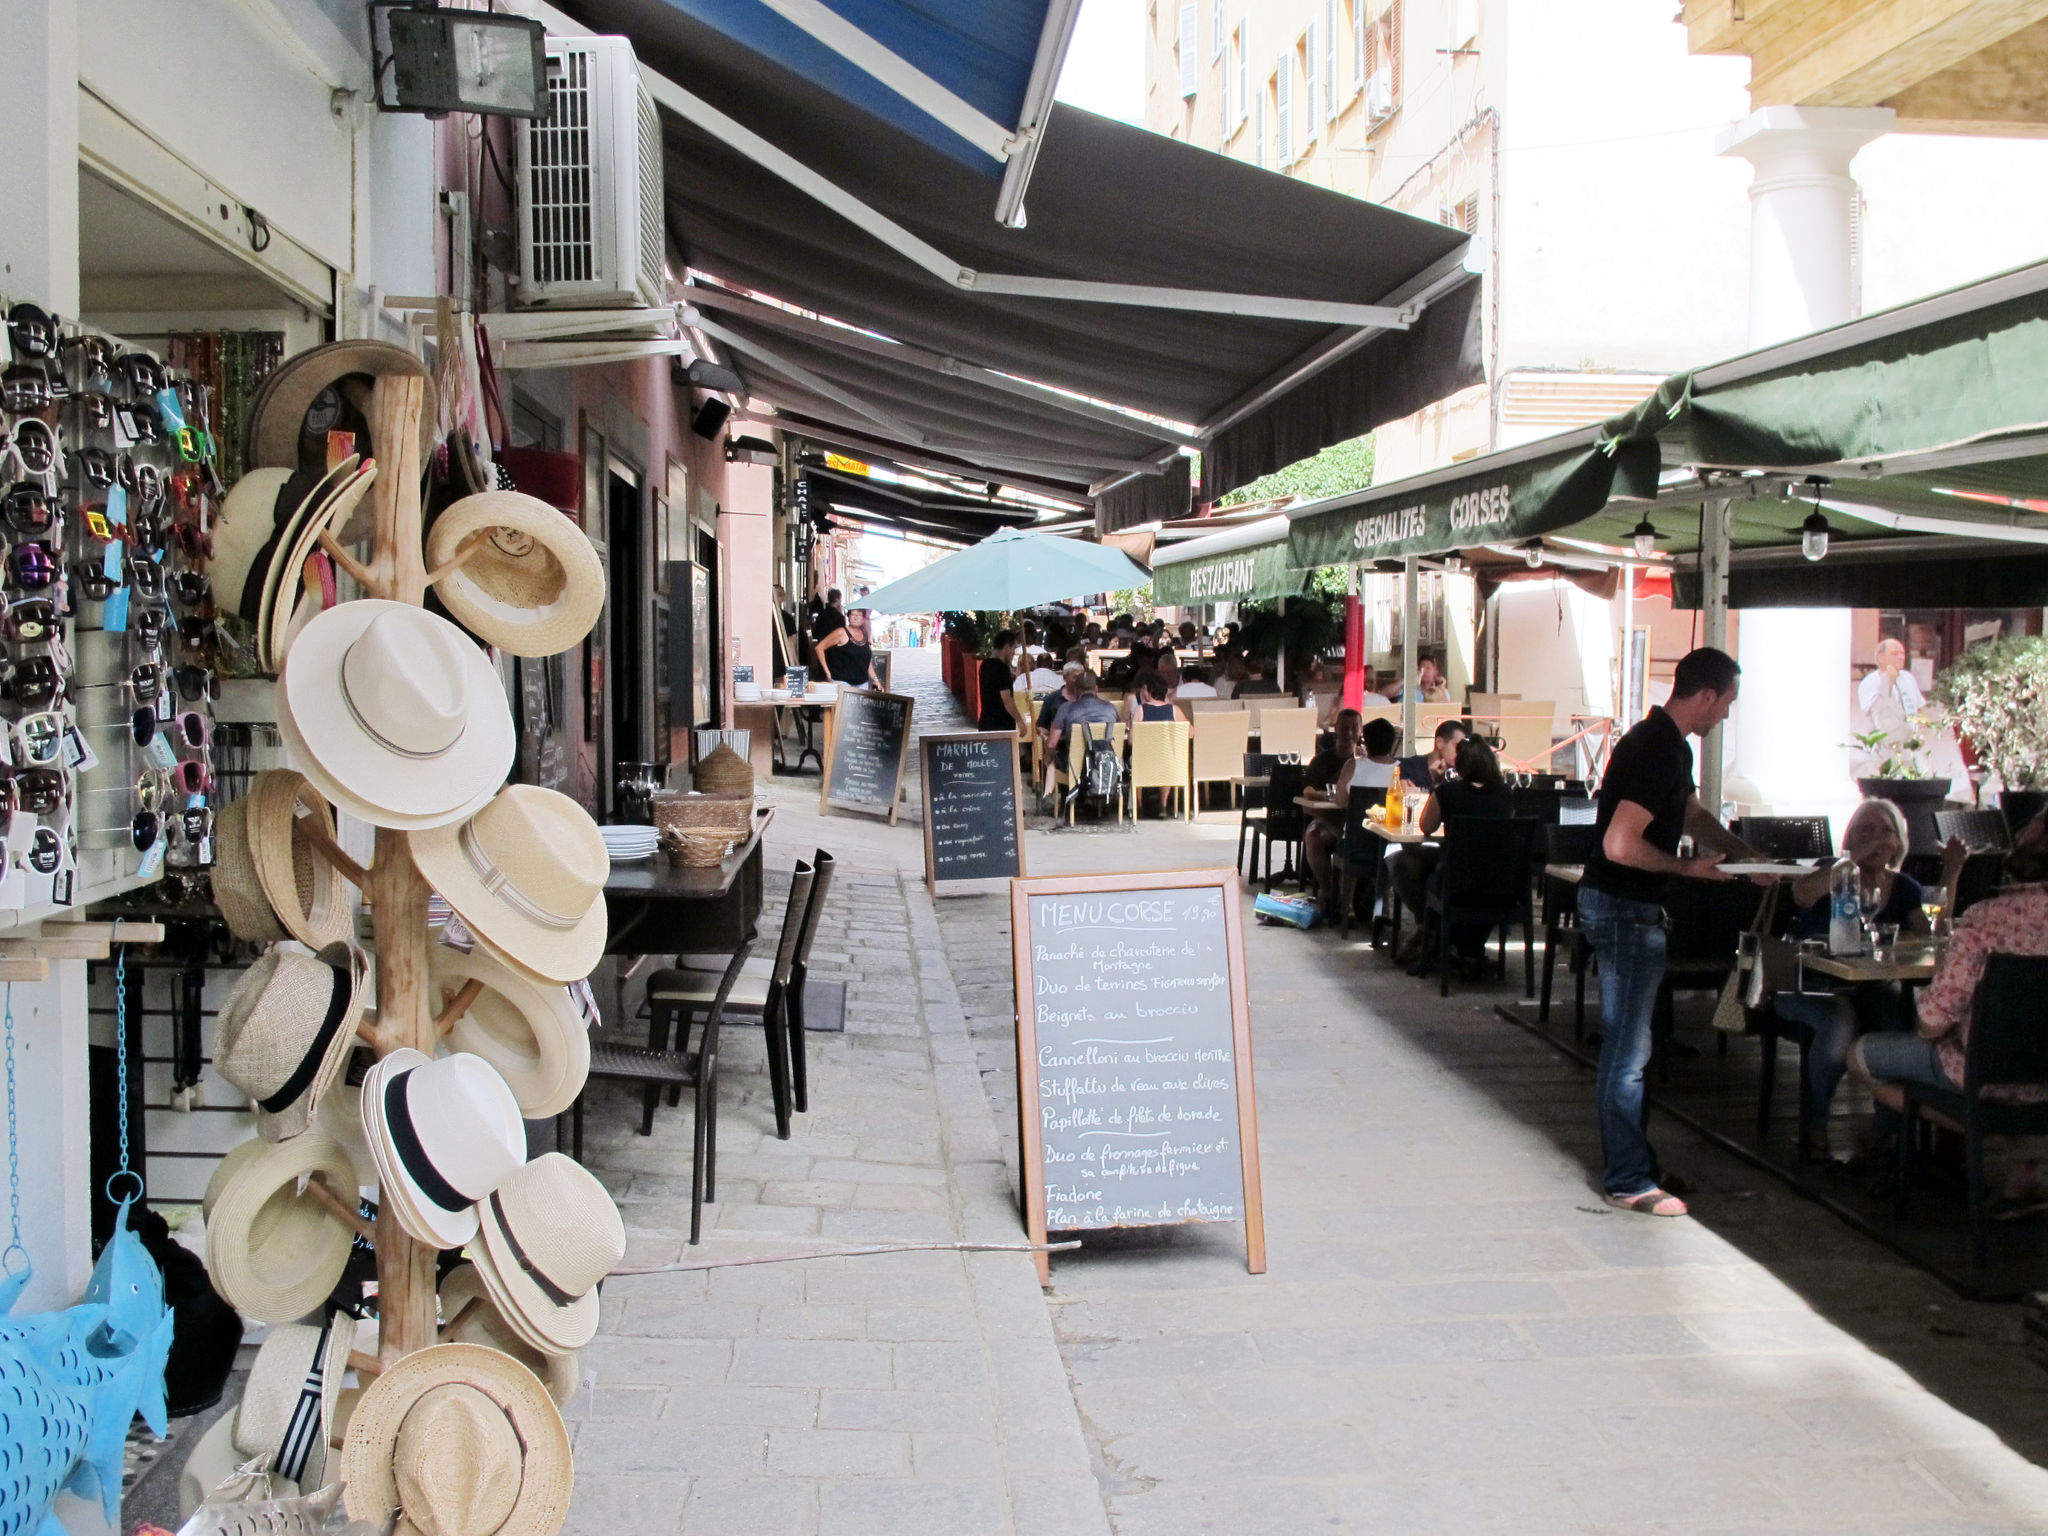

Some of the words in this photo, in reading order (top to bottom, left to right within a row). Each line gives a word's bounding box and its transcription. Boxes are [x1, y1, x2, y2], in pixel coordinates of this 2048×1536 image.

[1354, 503, 1426, 549] SPECIALITES
[1449, 483, 1511, 531] CORSES
[1189, 557, 1256, 598] RESTAURANT
[936, 742, 989, 757] MARMITE
[940, 762, 954, 771] DE
[1041, 901, 1102, 927] MENU
[1107, 900, 1176, 924] CORSE
[1091, 945, 1107, 959] de
[1109, 941, 1176, 958] charcuterie
[1036, 975, 1068, 995] Duo
[1075, 976, 1091, 991] de
[1104, 1010, 1127, 1019] au
[1039, 1045, 1118, 1067] Cannelloni
[1123, 1054, 1140, 1063] au
[1145, 1048, 1189, 1063] brocciu
[1111, 1076, 1126, 1091] de
[1130, 1077, 1159, 1091] veau
[1192, 1071, 1229, 1091] olives
[1108, 1108, 1123, 1124] de
[1157, 1104, 1172, 1122] de
[1177, 1105, 1223, 1122] dorade
[1044, 1143, 1075, 1164] Duo
[1080, 1146, 1095, 1161] de
[1100, 1143, 1159, 1169] fromages
[1081, 1168, 1096, 1178] sa
[1168, 1158, 1200, 1177] figue
[1045, 1183, 1103, 1203] Fiadone
[1046, 1207, 1077, 1225] Flan
[1083, 1210, 1093, 1224] à
[1095, 1205, 1109, 1223] la
[1112, 1205, 1152, 1224] farine
[1158, 1201, 1172, 1218] de
